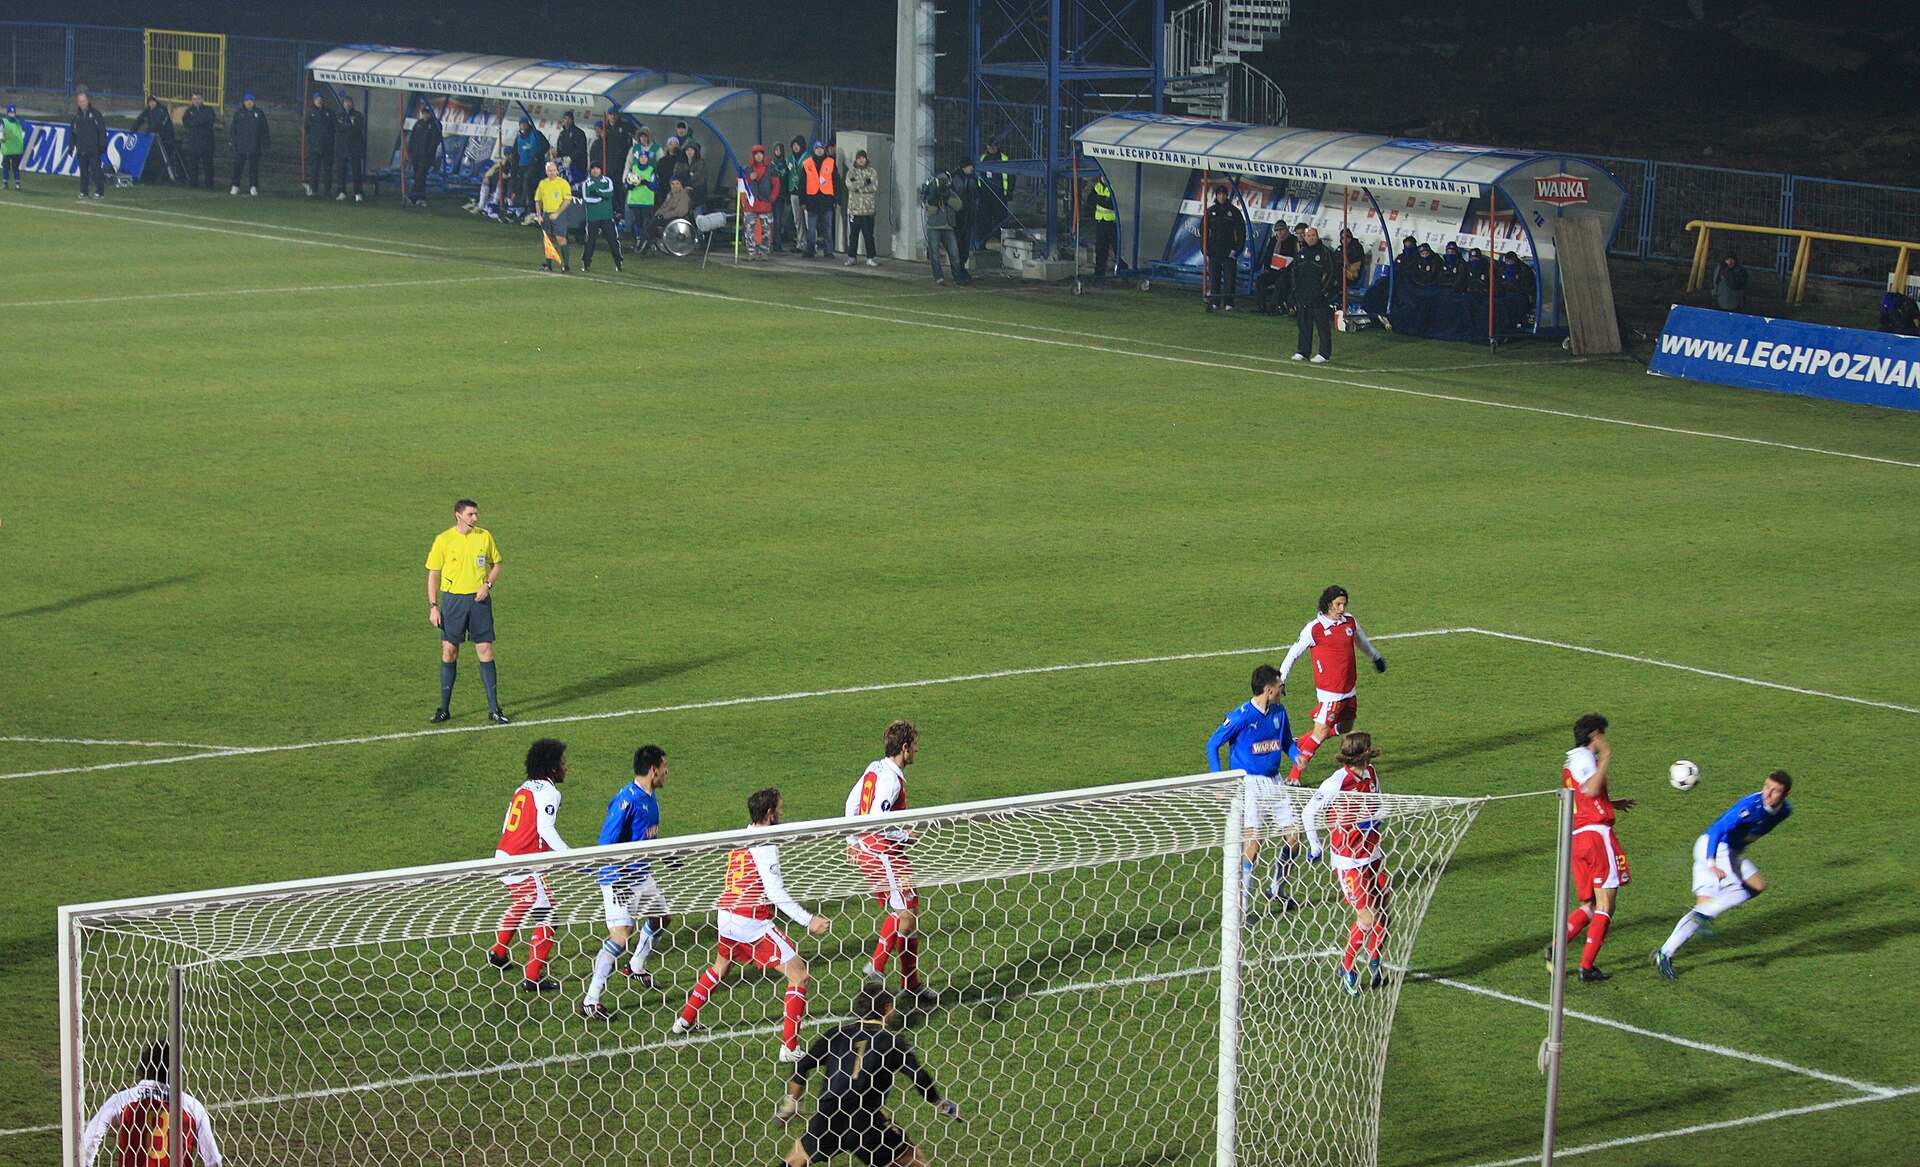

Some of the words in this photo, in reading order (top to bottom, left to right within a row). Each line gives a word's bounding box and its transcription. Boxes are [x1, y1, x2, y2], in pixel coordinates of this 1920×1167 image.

[320, 72, 396, 87] www.LECHPOZNAN.pl
[408, 81, 489, 97] www.LECHPOZNAN.pl
[501, 90, 588, 106] www.LECHPOZNAN.pl
[1092, 146, 1200, 167] www.LECHPOZNAN.pl
[1218, 161, 1333, 181] www.LECHPOZNAN.pl
[1350, 175, 1471, 195] www.LECHPOZNAN.pl
[1537, 180, 1585, 198] WARKA
[506, 794, 526, 832] 6
[852, 1039, 868, 1080] 1
[146, 1109, 169, 1160] 8
